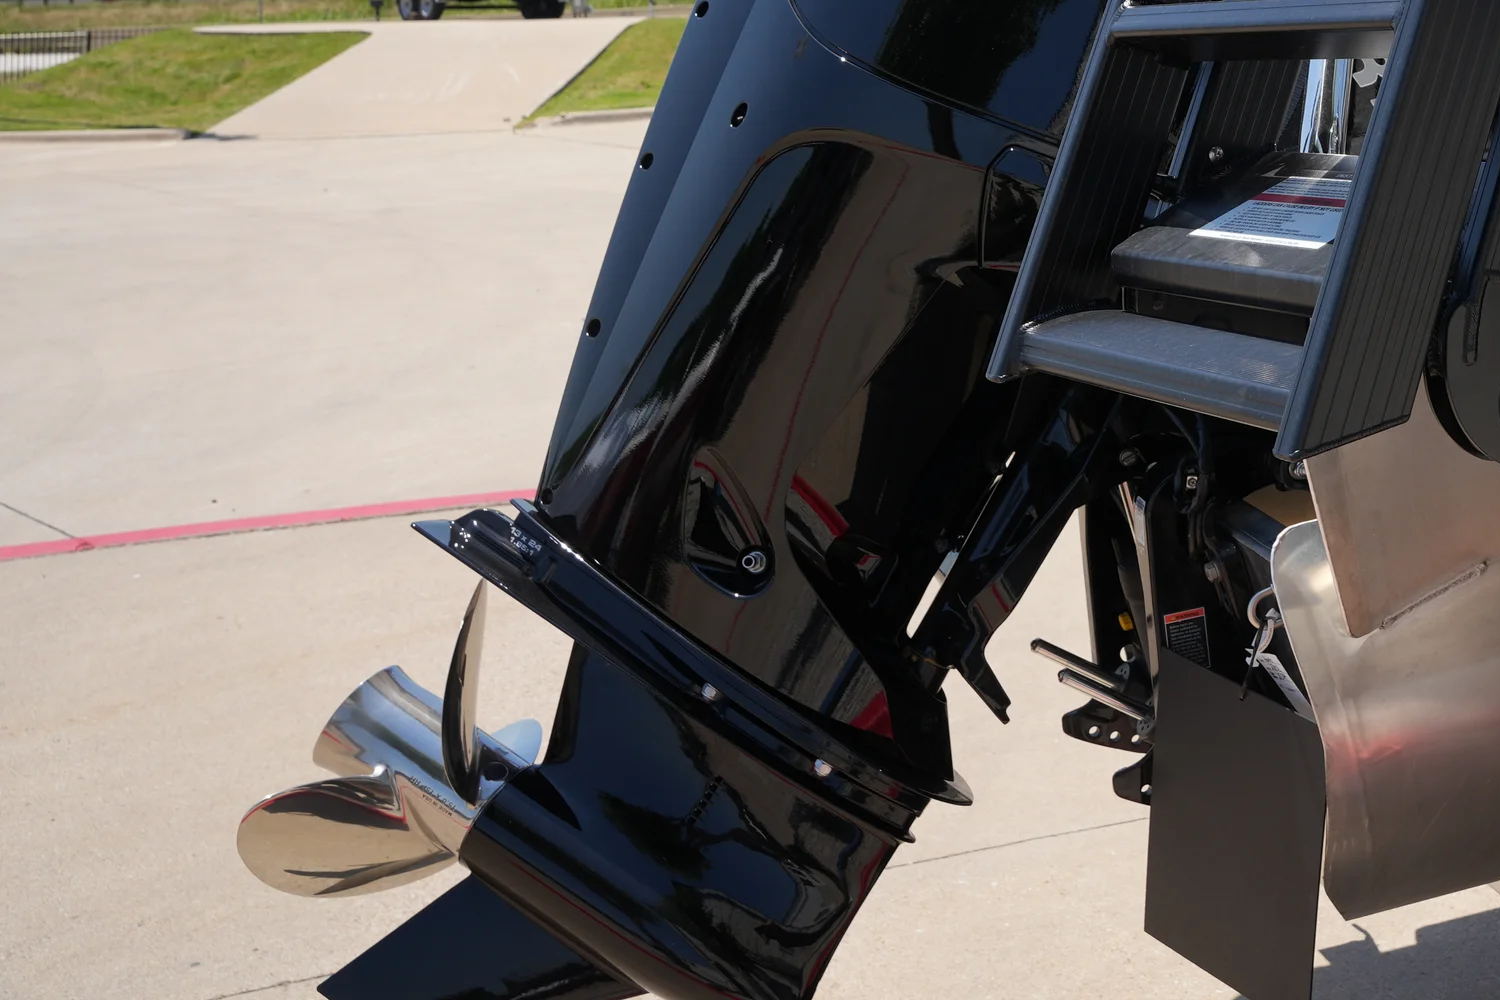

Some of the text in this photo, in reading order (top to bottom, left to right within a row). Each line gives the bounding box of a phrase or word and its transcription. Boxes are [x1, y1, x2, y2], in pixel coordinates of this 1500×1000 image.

[510, 526, 522, 538] 13
[528, 539, 542, 552] 24
[422, 794, 432, 803] USA
